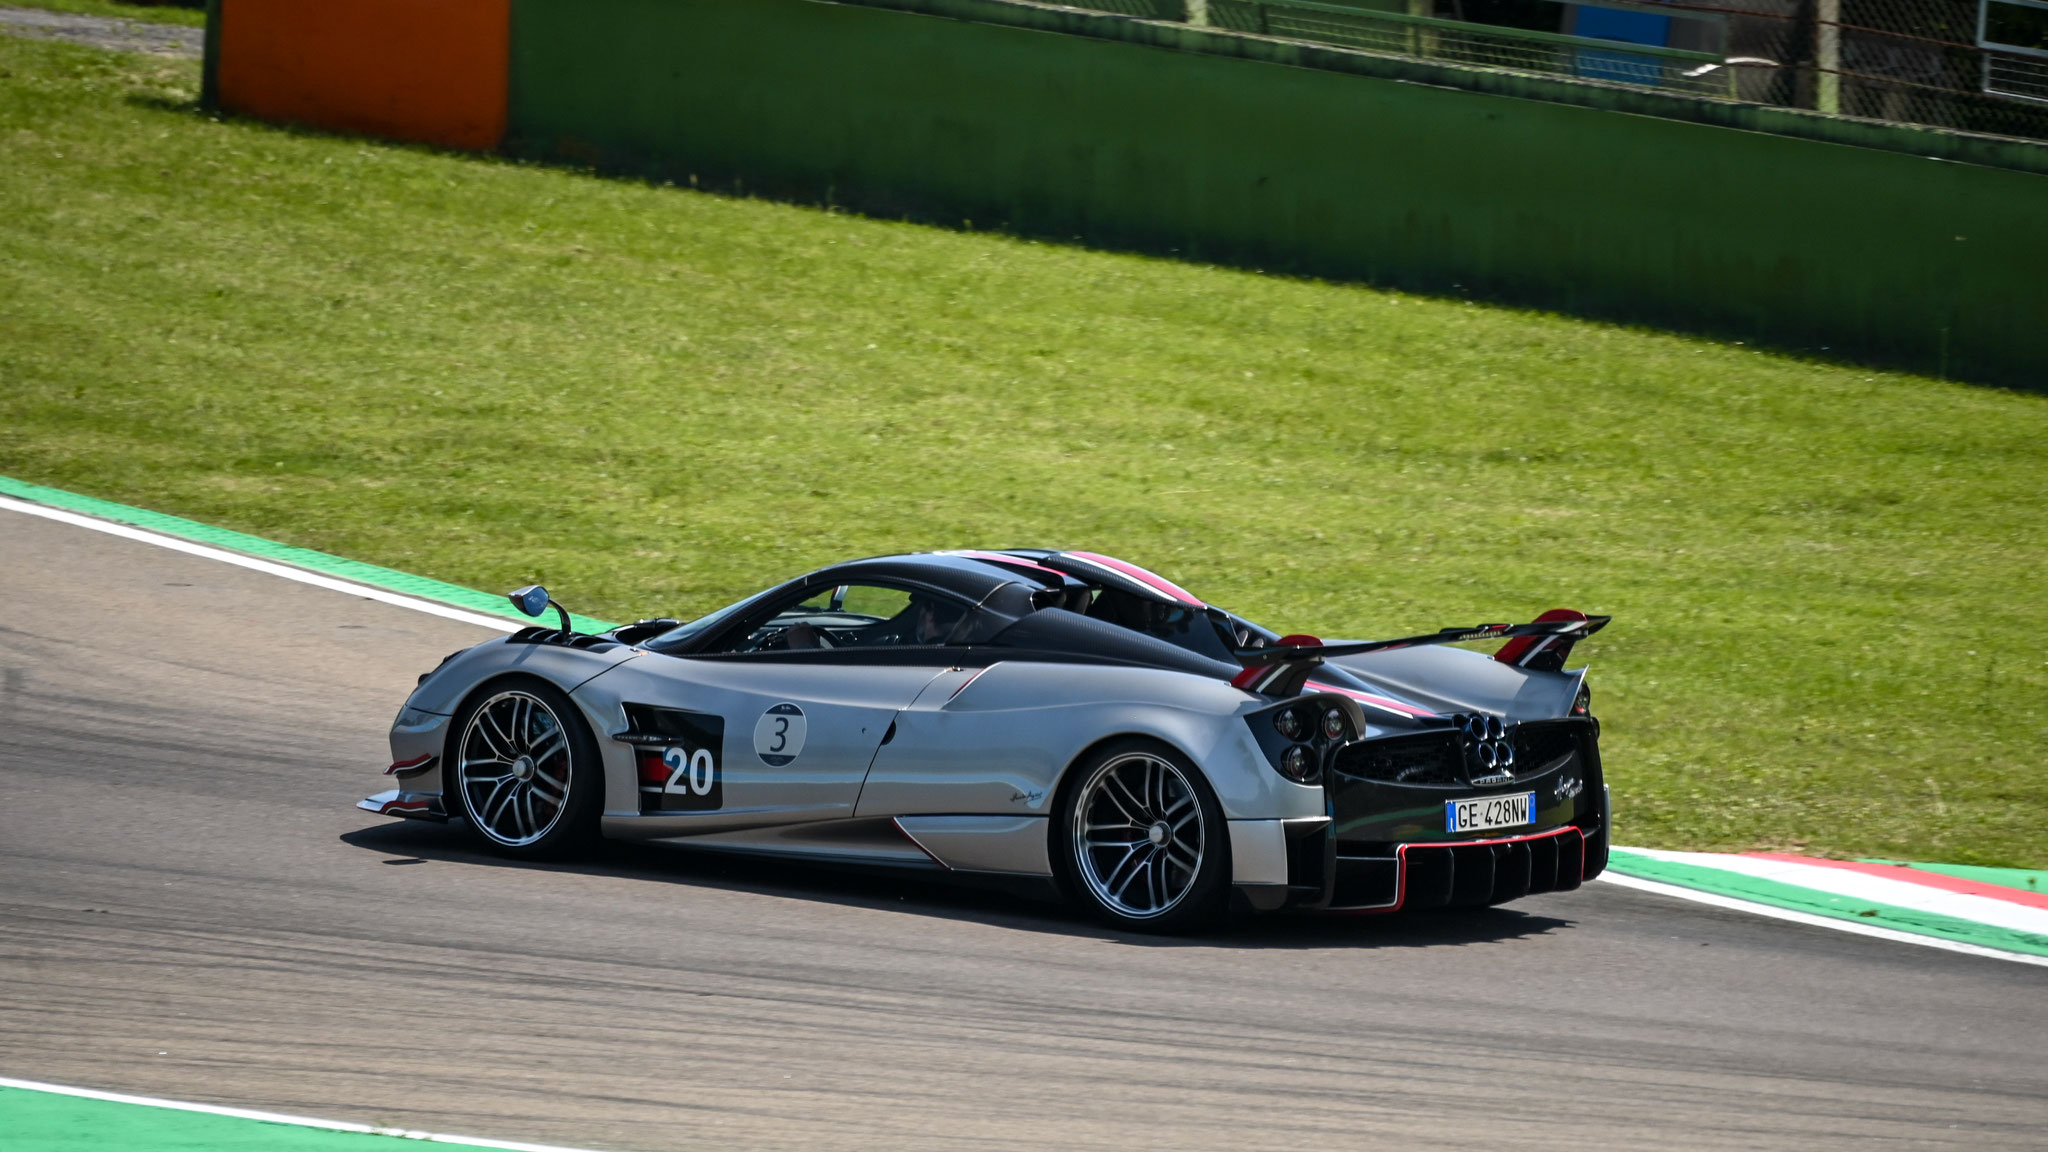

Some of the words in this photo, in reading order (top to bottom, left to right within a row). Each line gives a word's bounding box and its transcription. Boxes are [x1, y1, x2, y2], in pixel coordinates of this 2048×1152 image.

[770, 717, 789, 752] 3
[664, 747, 714, 796] 20
[1458, 803, 1478, 828] GE
[1485, 797, 1527, 826] 428NW
